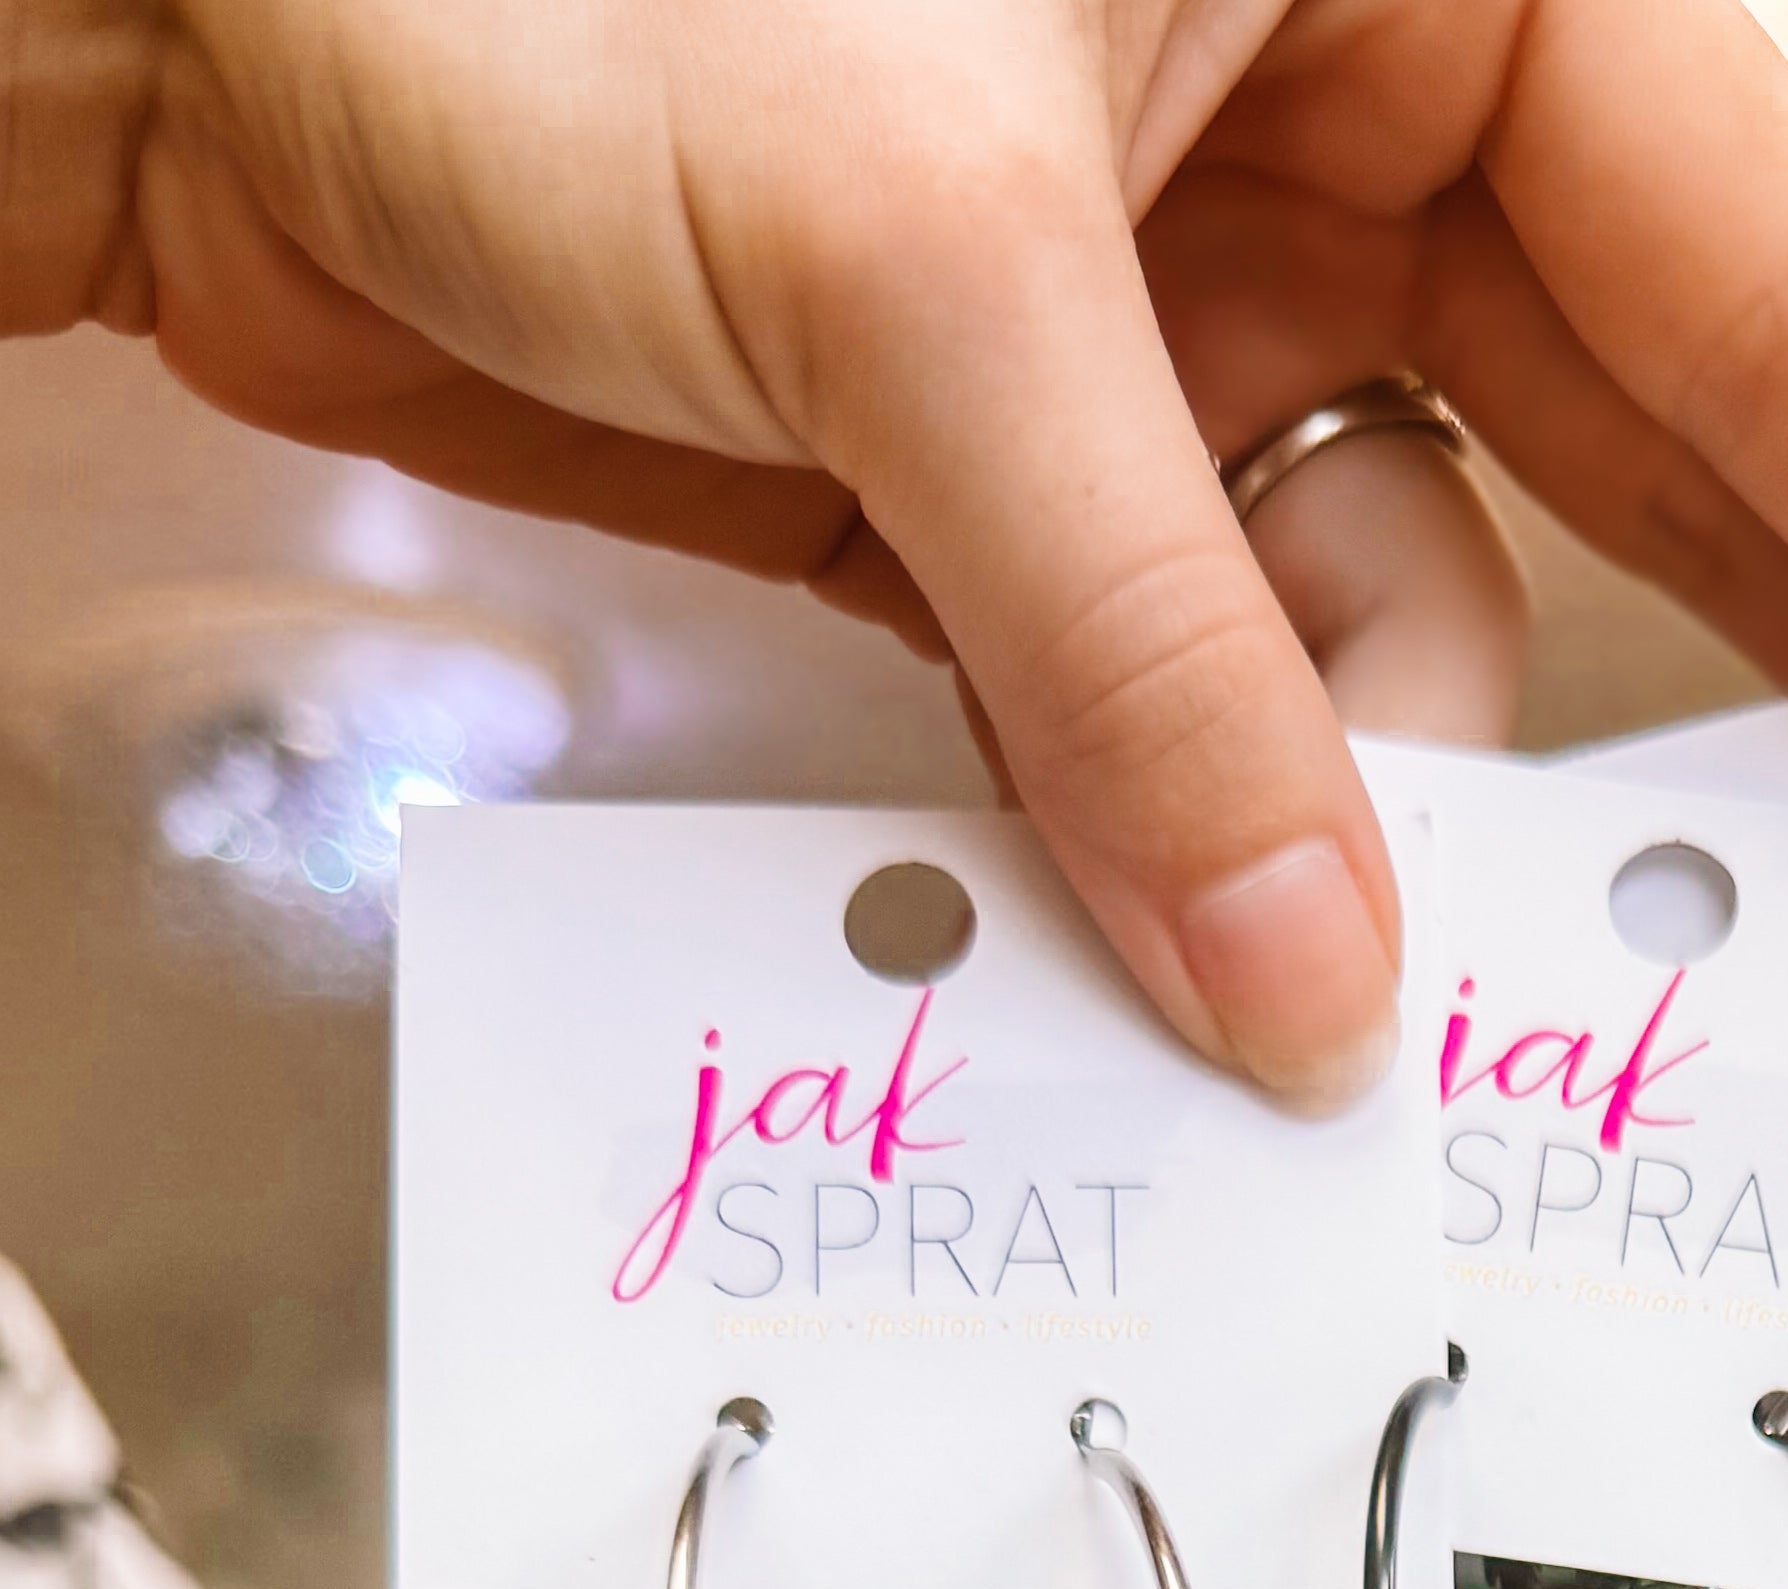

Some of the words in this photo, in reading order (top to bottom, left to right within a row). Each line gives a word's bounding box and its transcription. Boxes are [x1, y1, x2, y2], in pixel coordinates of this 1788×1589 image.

[612, 986, 969, 1303] jak
[710, 1183, 1151, 1299] SPRAT
[714, 1313, 833, 1344] jewelry
[865, 1312, 987, 1343] fashion
[1023, 1312, 1154, 1344] lifestyle
[1443, 1261, 1543, 1297] ewelry
[1569, 1271, 1689, 1315] fashion
